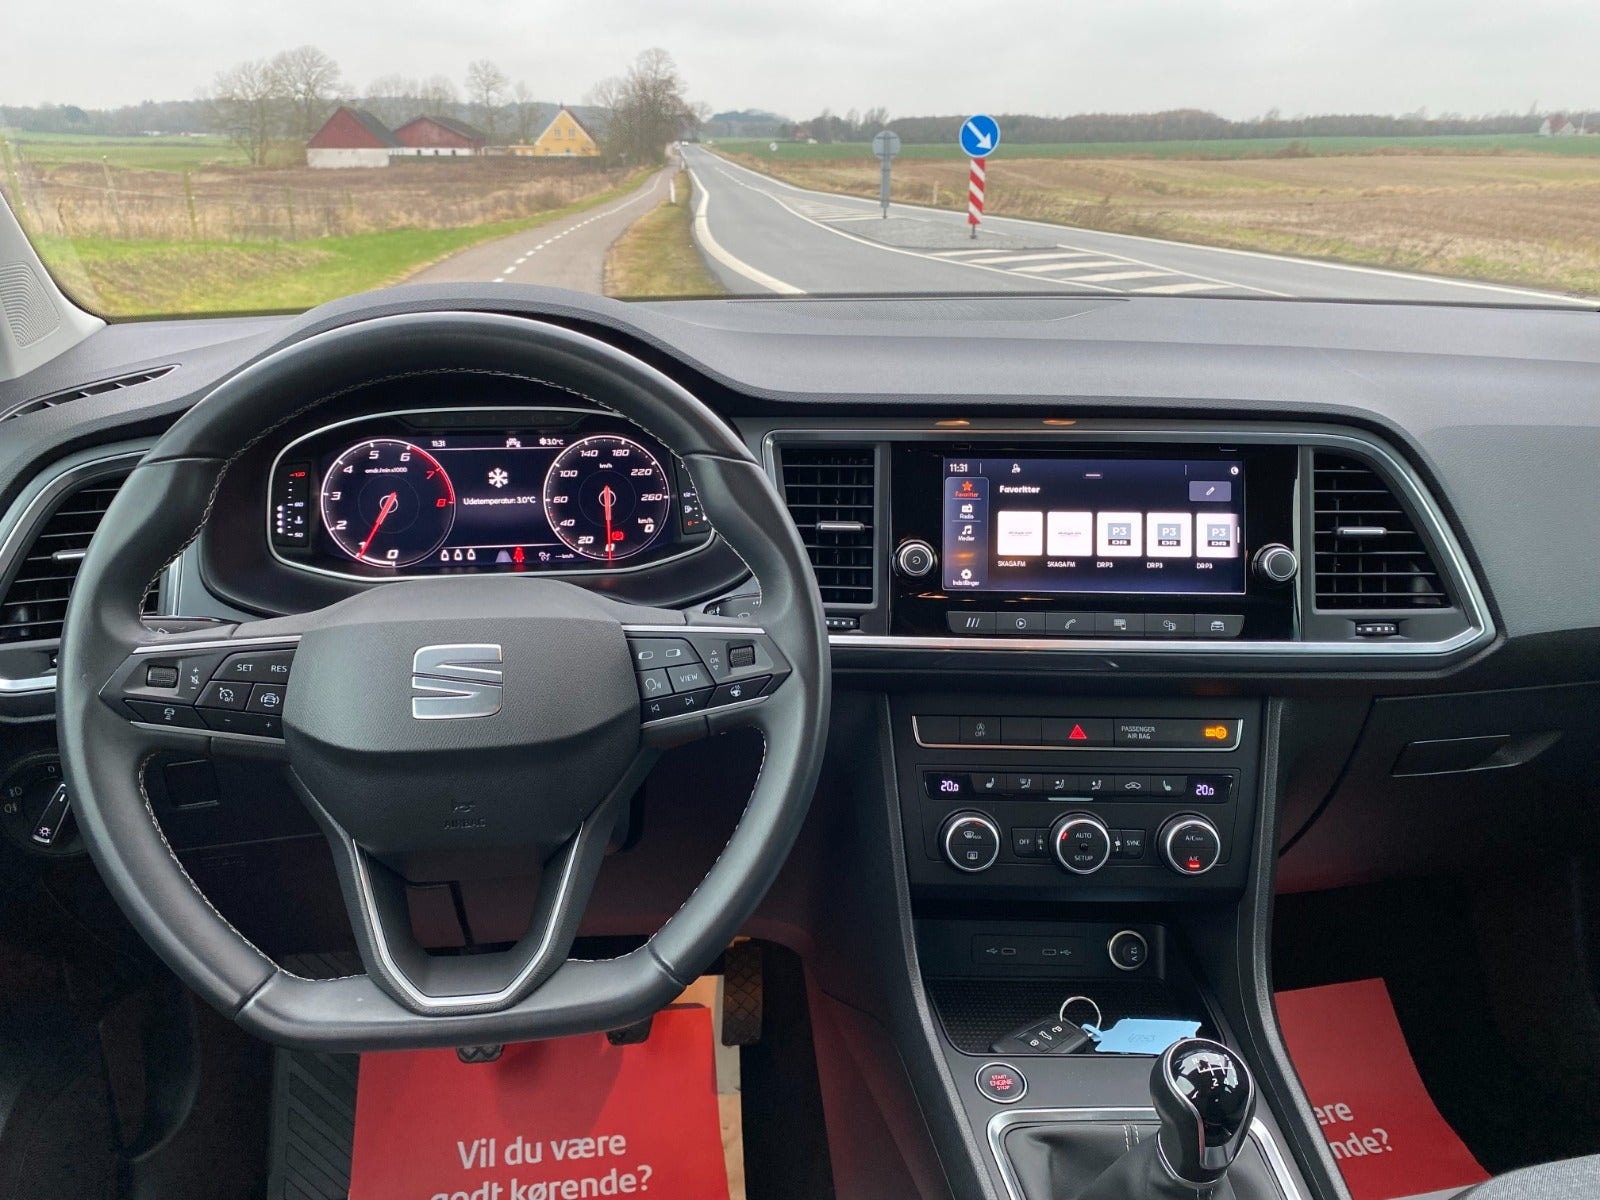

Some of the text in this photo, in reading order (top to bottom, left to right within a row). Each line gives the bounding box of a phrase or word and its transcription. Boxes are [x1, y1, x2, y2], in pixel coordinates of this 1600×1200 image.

[368, 451, 380, 459] 5
[399, 452, 411, 461] 6
[612, 449, 630, 457] 180
[343, 465, 353, 474] 4
[631, 468, 652, 476] 220
[950, 463, 968, 473] 11:31
[426, 471, 435, 479] 7
[999, 485, 1040, 494] Favoritter
[331, 491, 341, 500] 3
[553, 495, 568, 503] 60
[641, 493, 662, 502] 260
[436, 498, 446, 507] 8
[336, 520, 347, 530] 2
[560, 519, 575, 527] 40
[644, 523, 655, 533] 0
[1112, 527, 1127, 535] P3
[1162, 528, 1177, 536] P3
[1211, 528, 1226, 536] P3
[578, 536, 594, 545] 20
[386, 549, 398, 559] 0
[237, 663, 254, 672] SET
[271, 664, 288, 673] RES
[679, 673, 698, 683] VIEW
[1121, 725, 1156, 733] PASSENGER
[940, 780, 959, 792] 20.0
[1196, 784, 1214, 796] 20.0
[989, 1078, 1014, 1087] ENGINE
[1212, 1077, 1219, 1087] 2
[457, 1134, 627, 1170] Vil du være
[511, 1164, 653, 1200] kørende?
